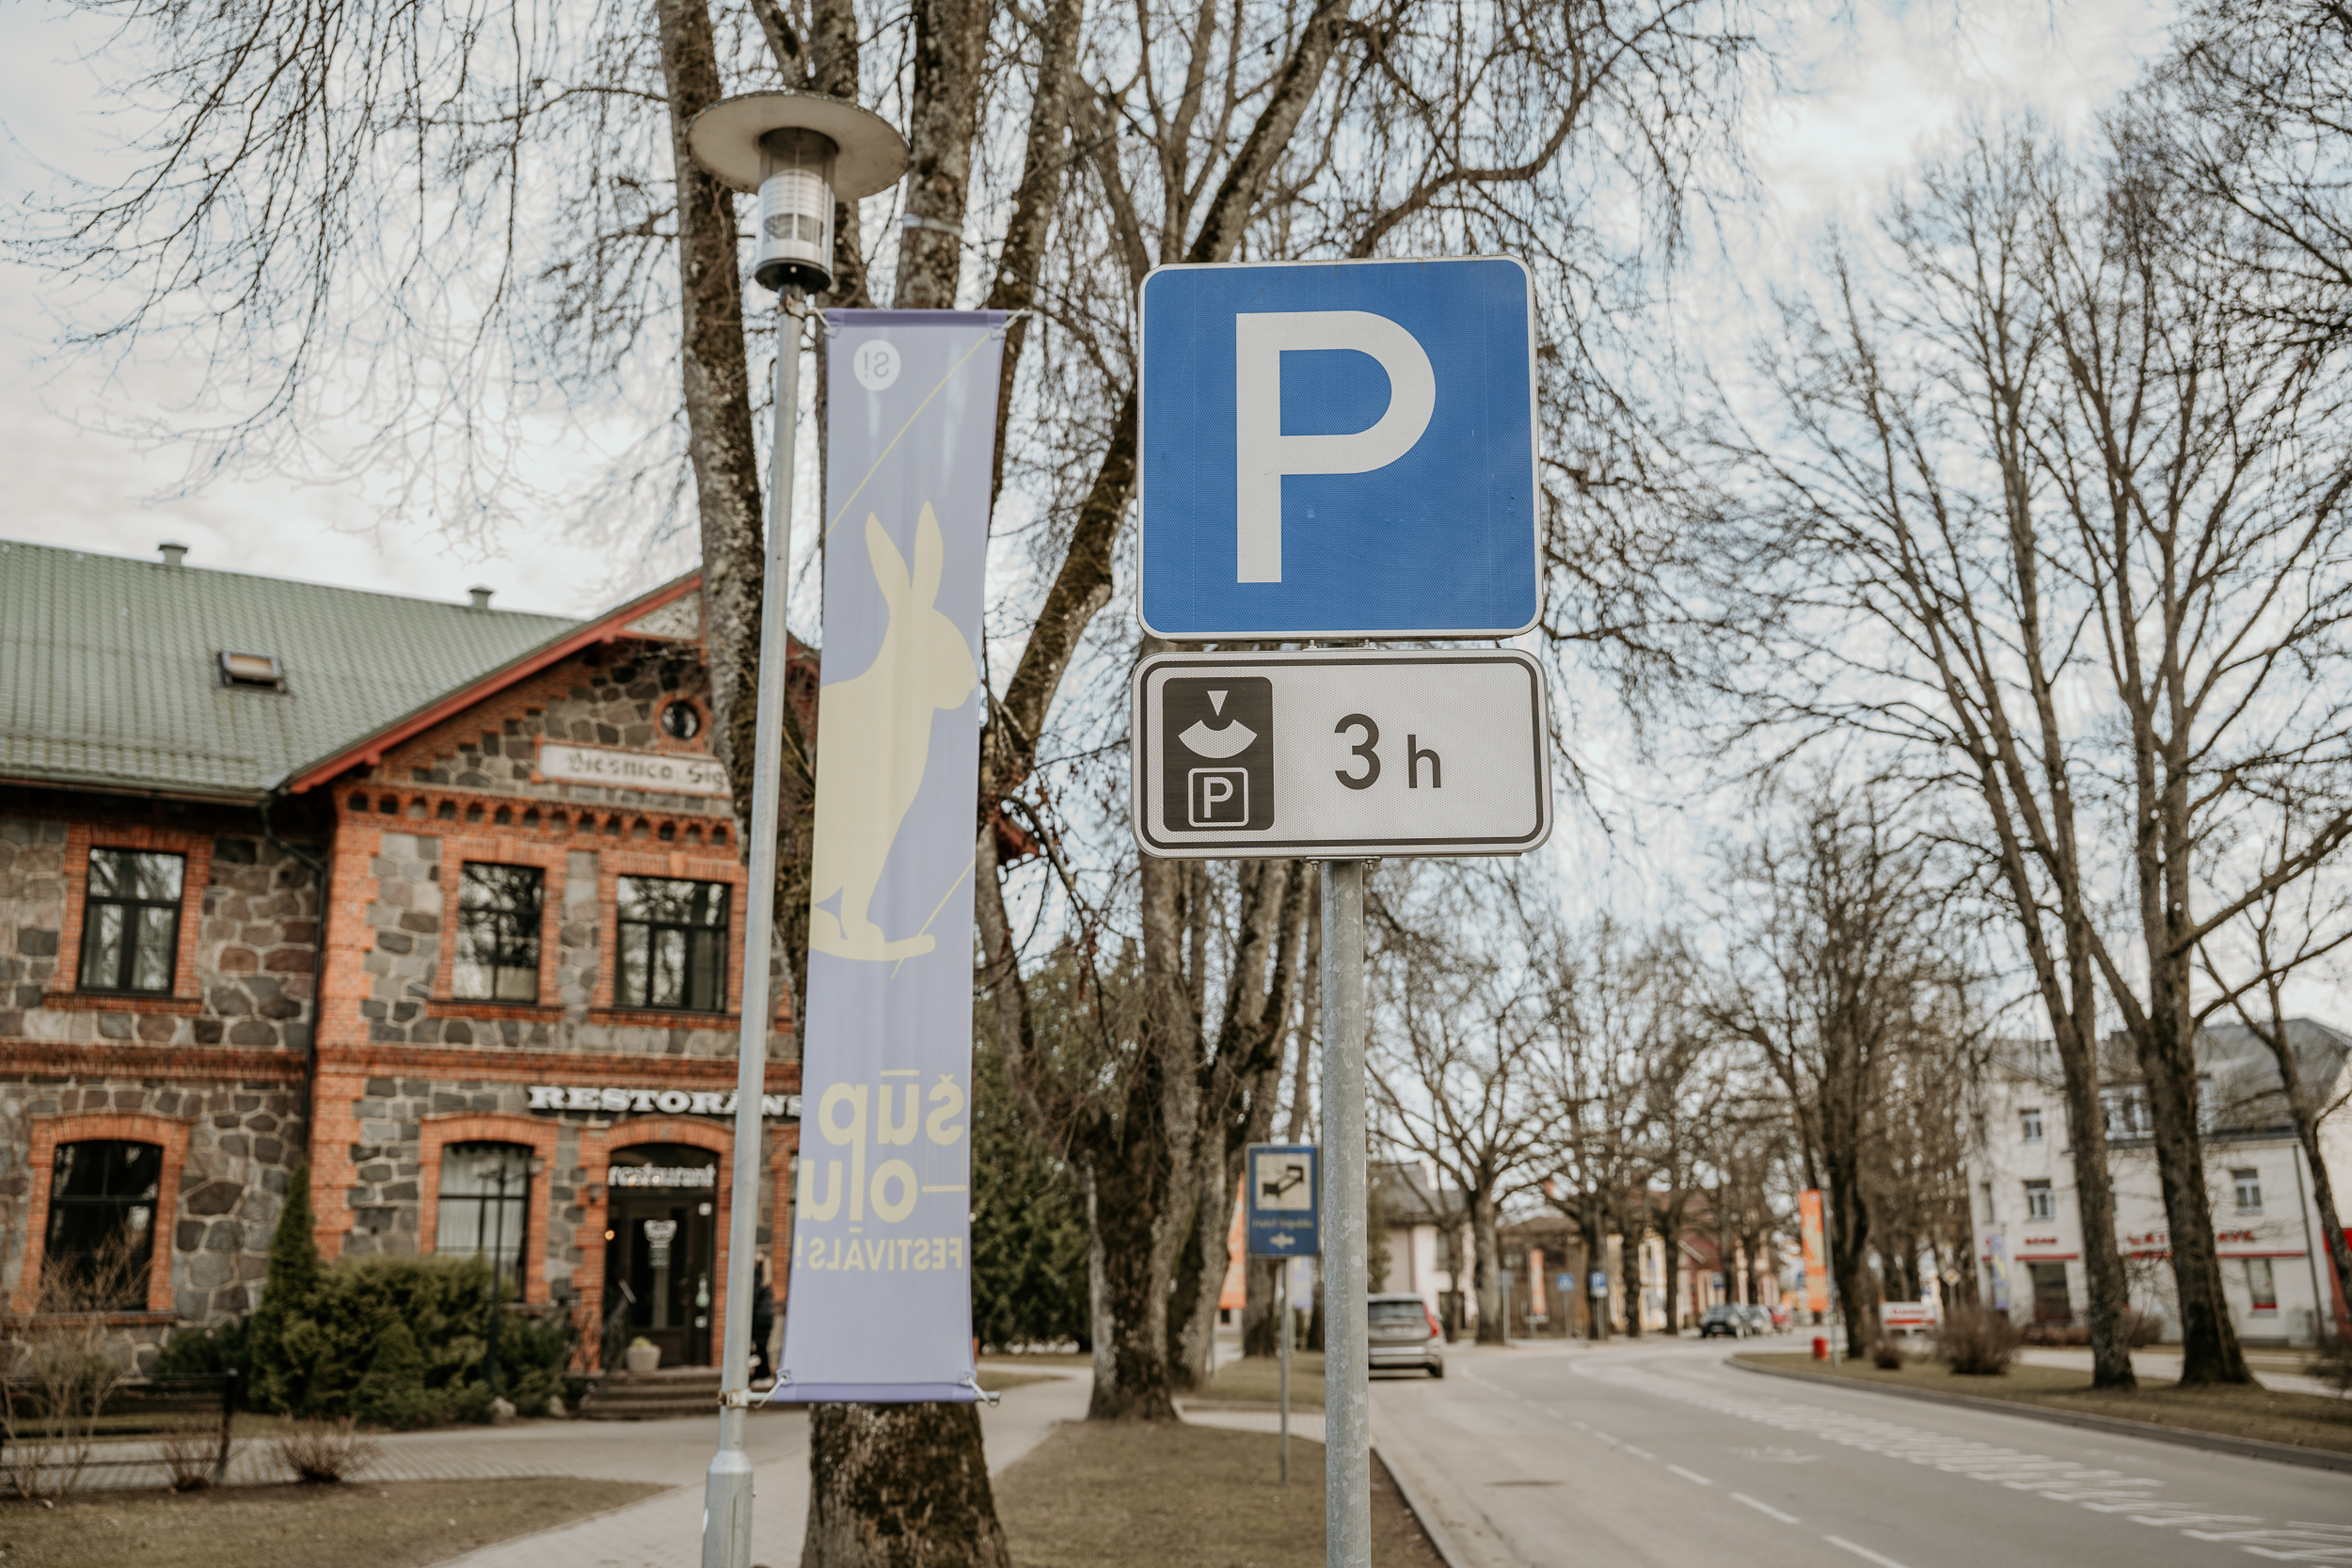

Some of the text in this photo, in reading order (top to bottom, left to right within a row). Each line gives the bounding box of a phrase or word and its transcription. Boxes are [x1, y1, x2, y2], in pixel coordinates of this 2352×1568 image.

[1236, 310, 1437, 583] P
[1334, 713, 1441, 790] 3 h
[1203, 776, 1233, 818] P
